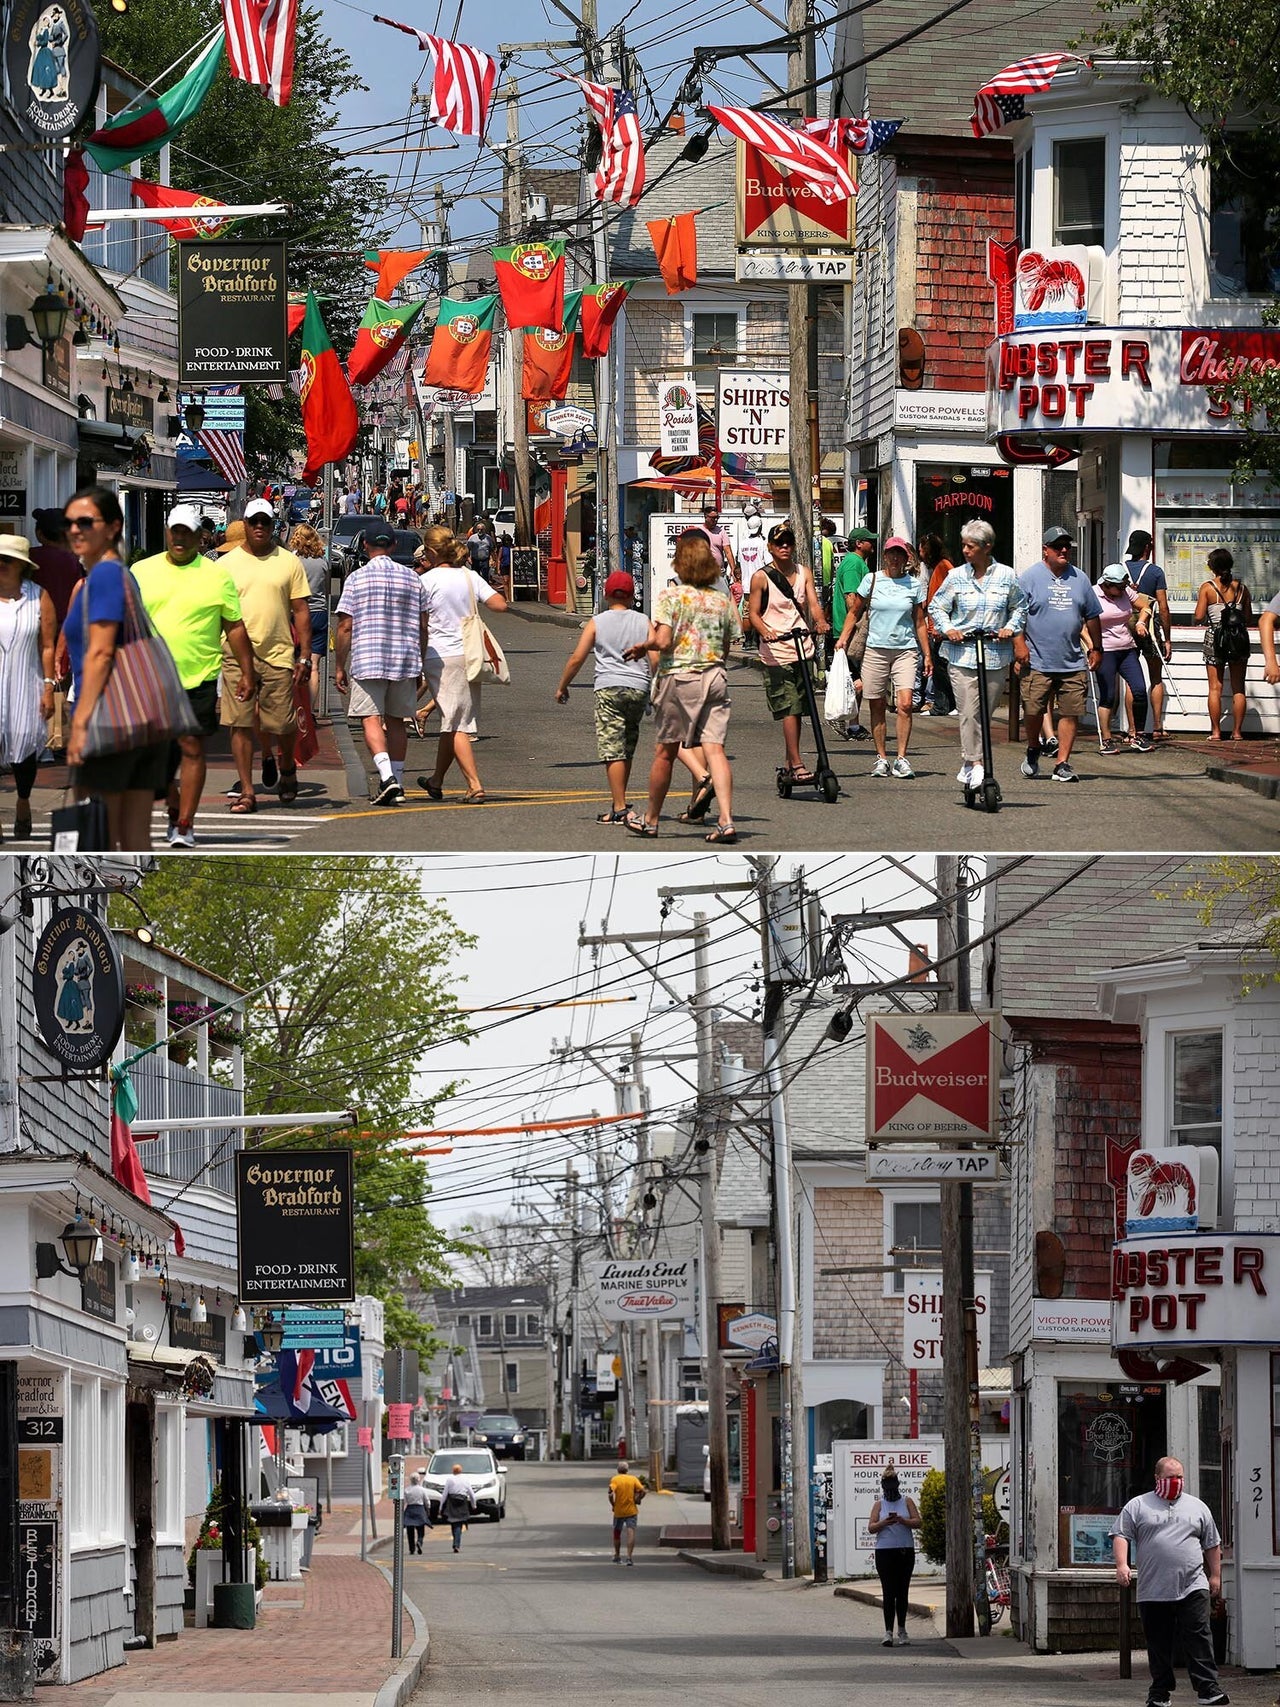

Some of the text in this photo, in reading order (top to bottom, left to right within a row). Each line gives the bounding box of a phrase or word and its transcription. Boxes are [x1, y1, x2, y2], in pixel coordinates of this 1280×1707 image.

[26, 106, 79, 131] ENTERTAINMENT
[29, 101, 50, 121] FOOD
[746, 178, 820, 198] Budwe
[757, 230, 780, 238] KING
[783, 230, 796, 238] OF
[187, 251, 271, 273] Governor
[817, 262, 847, 275] TAP
[202, 273, 277, 293] Bradford
[221, 294, 276, 302] RESTAURANT
[194, 346, 273, 358] FOOD DRINK
[186, 360, 282, 371] ENTERTAINMENT
[722, 388, 790, 407] SHIRTS
[1019, 383, 1095, 420] POT
[549, 412, 592, 423] KENNETH SCOTT
[899, 405, 985, 416] VICTOR POWELL'S
[662, 412, 695, 428] Rosie's
[726, 427, 785, 445] STUFF
[671, 444, 688, 452] CANTINA
[933, 492, 993, 512] HARPOON
[37, 914, 112, 976] Governor Bradford
[52, 1038, 105, 1063] ENTERTAINMENT
[56, 1032, 100, 1054] FOOD DRINK
[875, 1066, 987, 1087] Budweiser
[888, 1123, 968, 1131] KING OF BEERS
[956, 1158, 989, 1172] TAP
[247, 1163, 335, 1186] Governor
[262, 1184, 342, 1207] Bradford
[282, 1207, 341, 1217] RESTAURANT
[255, 1263, 338, 1276] FOOD DRINK
[599, 1261, 688, 1280] Lands End
[246, 1278, 347, 1290] ENTERTAINMENT
[601, 1279, 689, 1291] MARINE SUPPLY
[622, 1296, 644, 1308] True
[640, 1295, 674, 1308] Value
[907, 1294, 987, 1315] SHIS
[1129, 1293, 1206, 1332] POT
[732, 1322, 761, 1333] KENNETH
[1037, 1316, 1111, 1326] VICTOR POWE
[26, 1421, 57, 1436] 312
[853, 1454, 929, 1465] RENT a BIKE
[854, 1471, 928, 1479] HOUR WEEK
[854, 1486, 880, 1494] National
[26, 1529, 38, 1629] RESTAURANT
